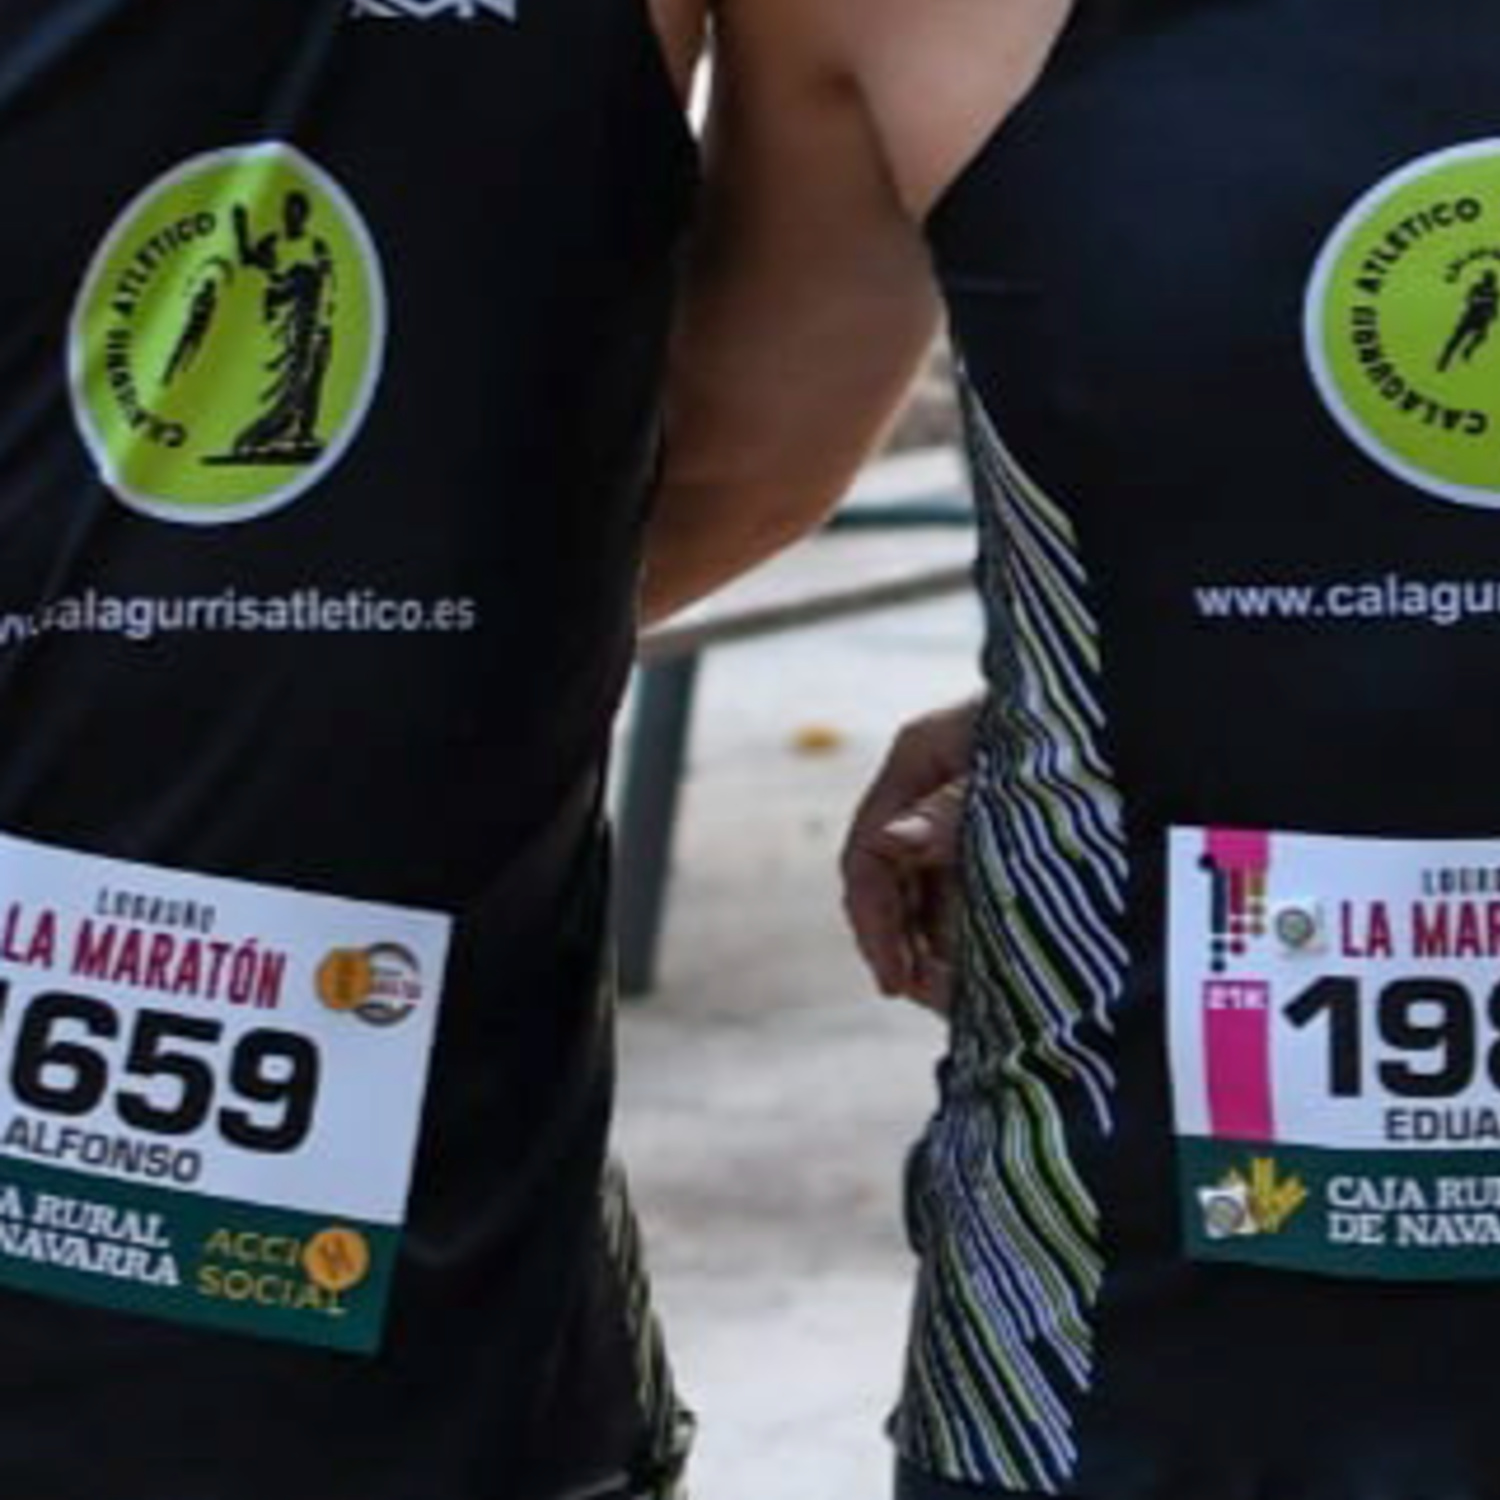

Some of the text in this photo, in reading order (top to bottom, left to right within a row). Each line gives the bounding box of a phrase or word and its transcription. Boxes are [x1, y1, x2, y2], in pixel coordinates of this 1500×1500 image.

[0, 902, 57, 970] LA
[71, 917, 287, 1009] MARATÓN
[1340, 899, 1392, 958] LA
[3, 1116, 203, 1182] ALFONSO
[1327, 1175, 1427, 1209] CAJA
[32, 1193, 171, 1249] RURAL
[204, 1228, 301, 1268] ACCI
[1327, 1211, 1385, 1244] DE
